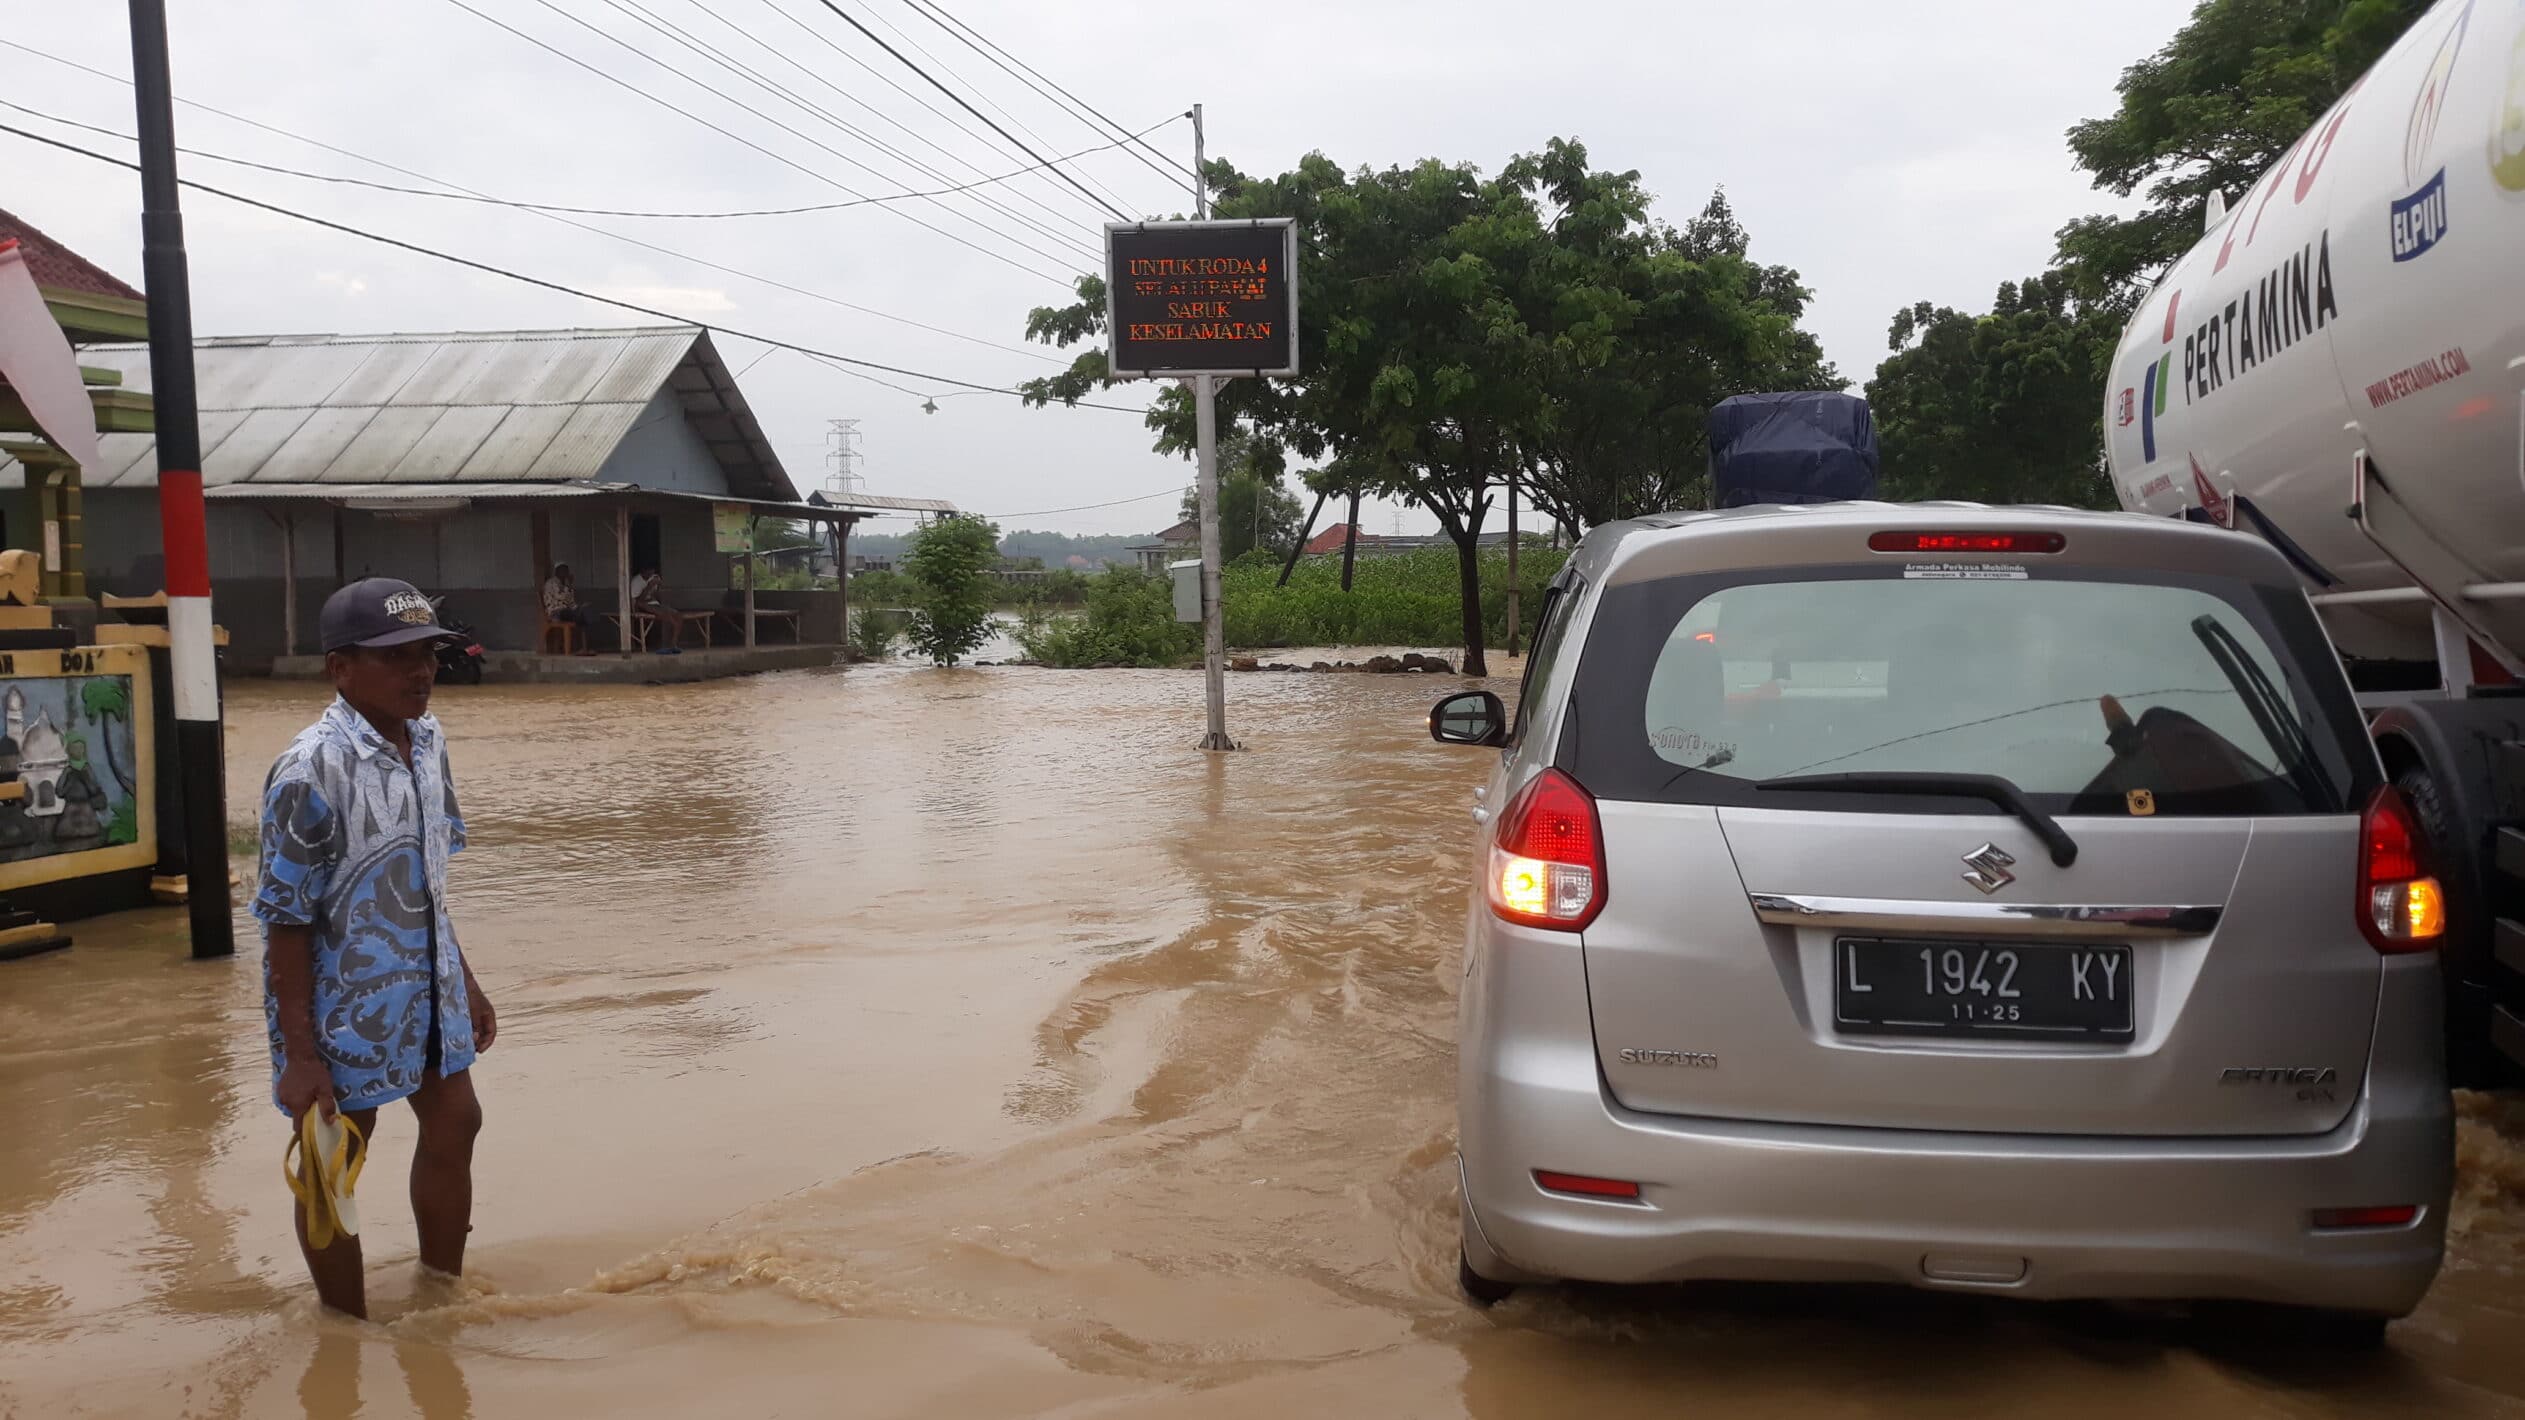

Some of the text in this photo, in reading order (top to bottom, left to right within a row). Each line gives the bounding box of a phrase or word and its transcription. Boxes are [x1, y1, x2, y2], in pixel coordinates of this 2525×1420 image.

[2393, 184, 2445, 257] ELPIJI
[1129, 257, 1269, 276] UNTUK RODA 4
[1168, 301, 1232, 319] SABUK
[2184, 228, 2338, 406] PERTAMINA
[1128, 322, 1272, 340] KESELAMATAN
[2365, 346, 2471, 409] WWW.PERTAMINA.COM
[1905, 563, 1940, 571] Armada
[1943, 563, 1980, 571] Perkasa
[1849, 945, 2120, 1000] L 1942 KY
[1620, 1048, 1718, 1068] SUZUKI
[2219, 1067, 2336, 1086] ERTIGA
